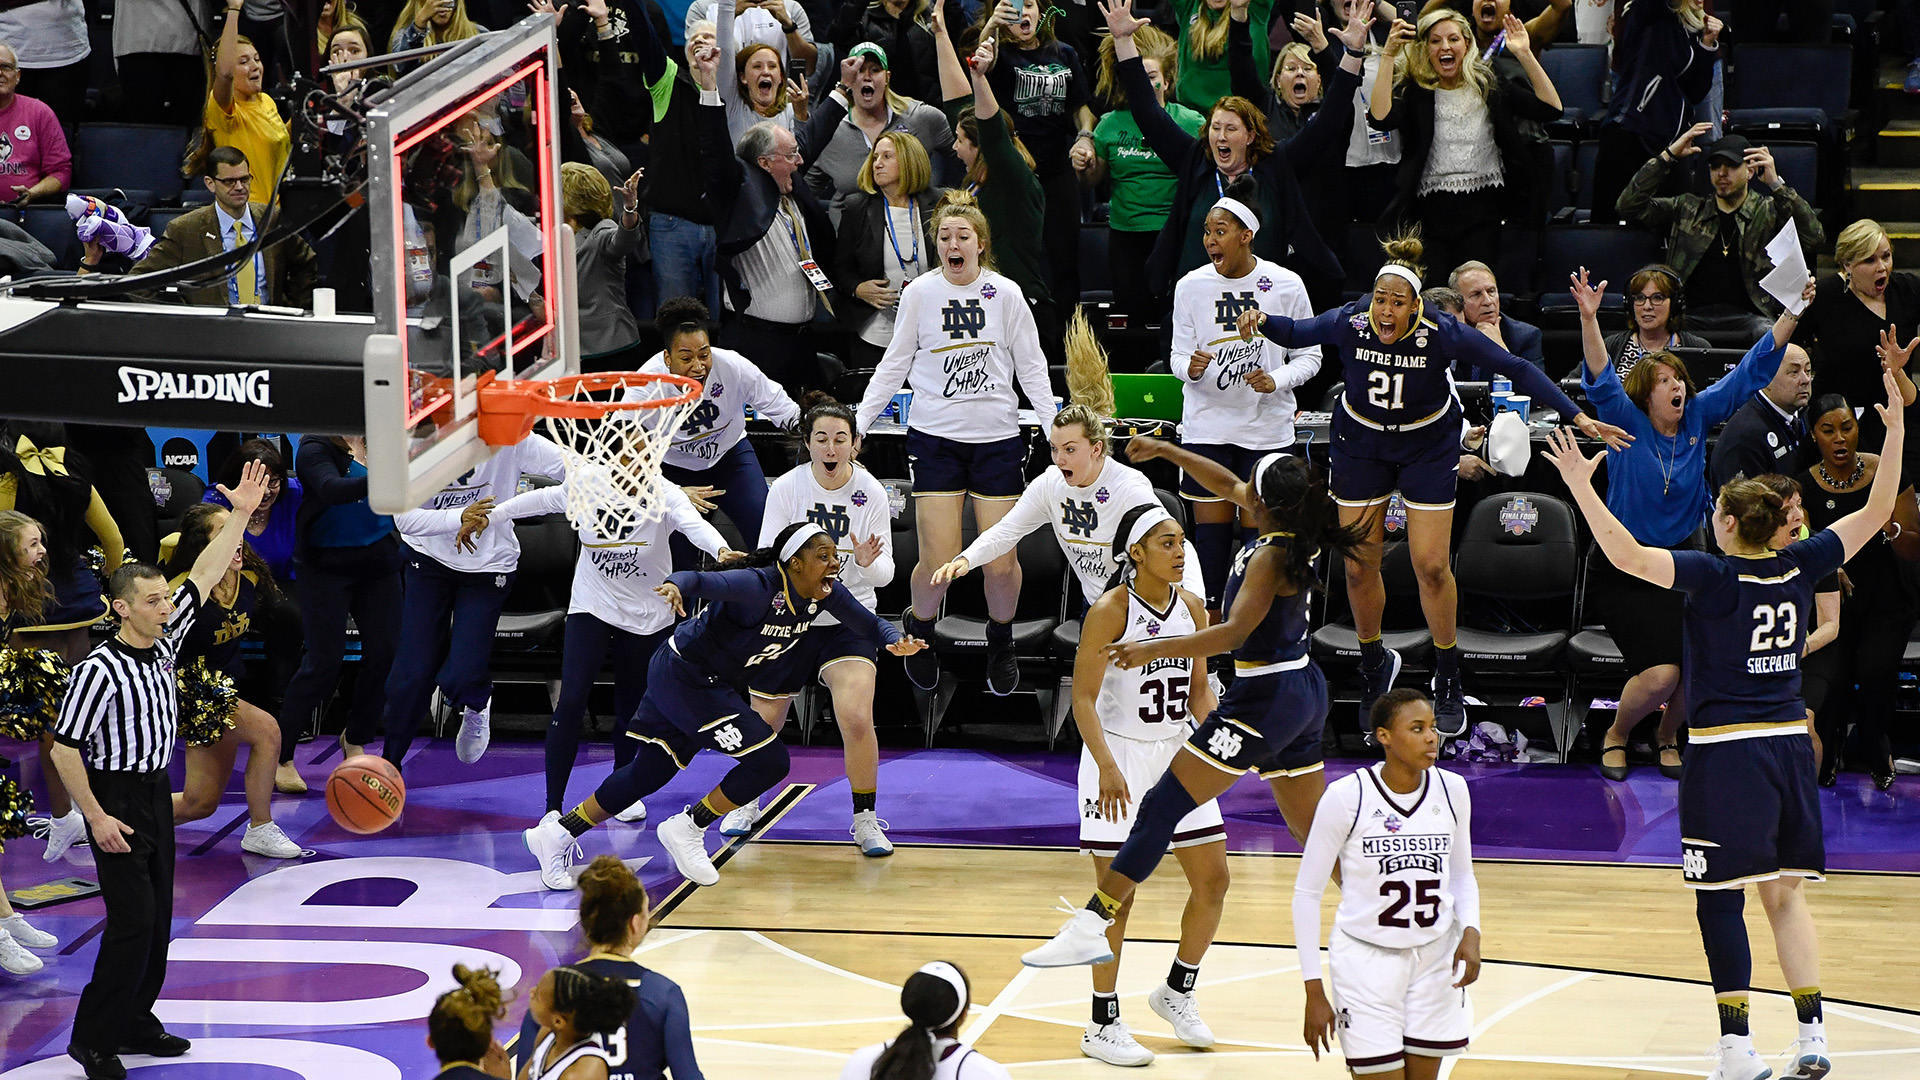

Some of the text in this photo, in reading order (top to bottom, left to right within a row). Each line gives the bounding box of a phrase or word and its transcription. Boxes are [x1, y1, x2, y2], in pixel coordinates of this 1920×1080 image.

[1017, 73, 1050, 99] NOTRE
[1117, 147, 1152, 160] Fighting
[943, 347, 990, 374] UNLEASH
[1217, 340, 1264, 366] UNLEASH
[1355, 348, 1427, 368] NOTRE DAME
[118, 366, 272, 408] SPALDING
[943, 361, 989, 398] CHAOS
[1367, 370, 1405, 410] 21
[165, 455, 199, 466] NCAA
[433, 489, 481, 510] UNLEASH
[1501, 512, 1537, 521] FINAL FOUR
[1749, 601, 1798, 652] 23
[1150, 657, 1186, 672] STATE
[1747, 652, 1797, 674] SHEPARD
[1138, 676, 1190, 724] 35
[1388, 854, 1435, 872] STATE
[1378, 879, 1442, 928] 25
